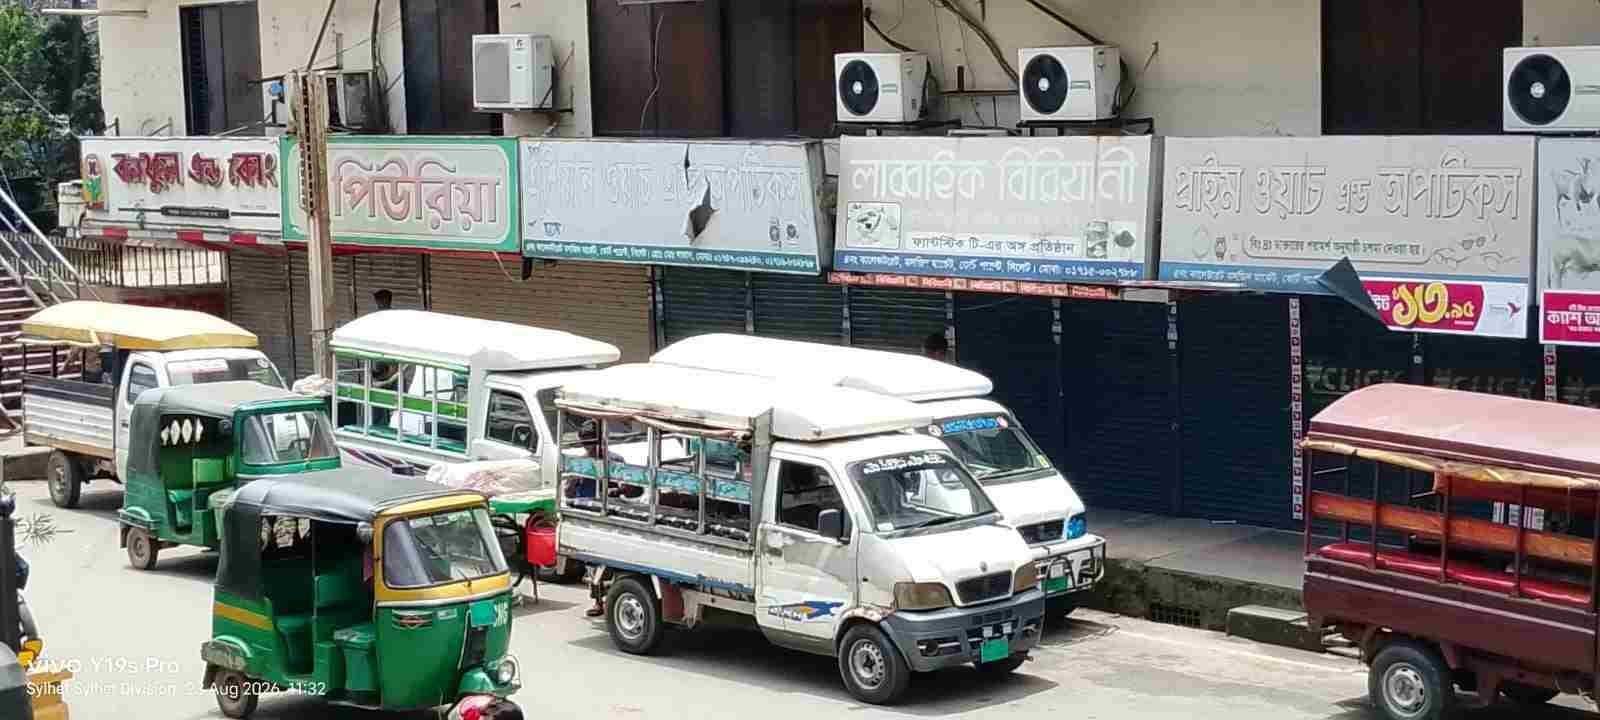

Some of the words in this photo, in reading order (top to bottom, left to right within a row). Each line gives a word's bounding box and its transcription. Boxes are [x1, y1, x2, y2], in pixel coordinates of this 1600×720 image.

[331, 153, 501, 231] পিউরিয়া
[850, 149, 991, 200] লাব্বাইক
[995, 146, 1139, 209] বিরিয়ানী
[1175, 151, 1246, 217] প্রাইম
[1256, 156, 1327, 219] ওয়াচ
[1336, 178, 1373, 214] এন্ড
[1377, 147, 1523, 219] অপটিকস
[1028, 239, 1075, 254] প্রতিষ্ঠান
